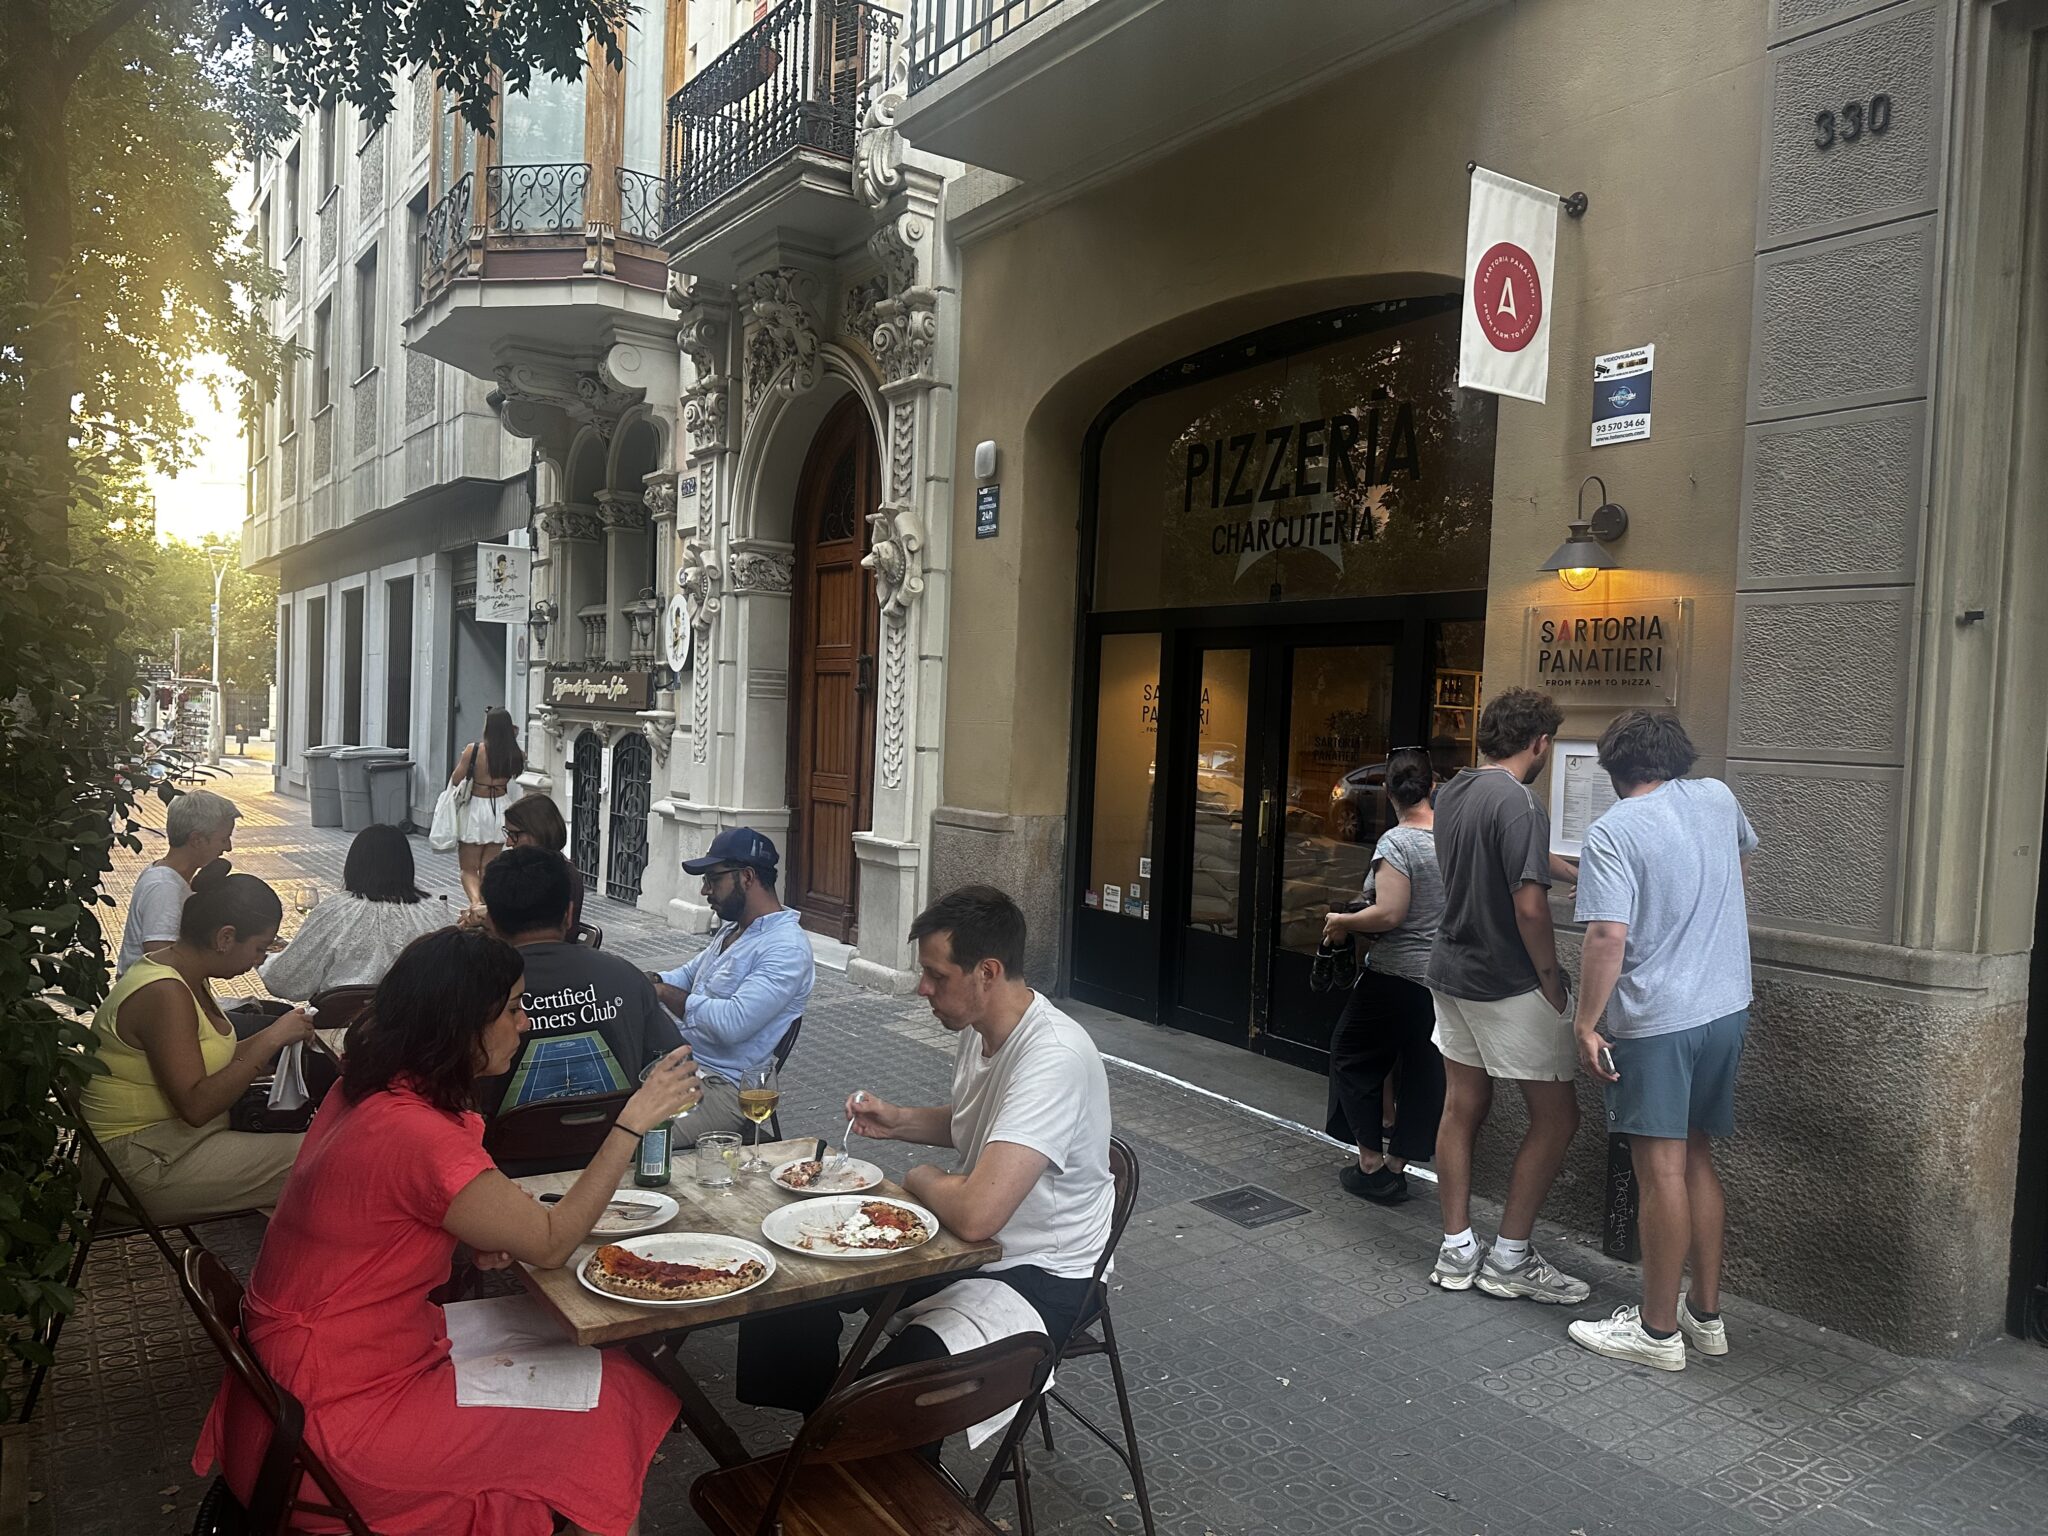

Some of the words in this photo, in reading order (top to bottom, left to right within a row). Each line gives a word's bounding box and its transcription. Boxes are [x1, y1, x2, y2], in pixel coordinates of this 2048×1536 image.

[1815, 94, 1890, 147] 330
[1484, 256, 1508, 283] SARTORIA
[1596, 425, 1606, 433] 93
[1608, 423, 1622, 432] 570
[1624, 421, 1633, 429] 34
[1635, 418, 1645, 427] 66
[1212, 506, 1375, 555] CHARCUTERIA
[1541, 615, 1663, 643] SARTORIA
[1538, 647, 1662, 673] PANATIERI
[1621, 678, 1651, 686] PIZZA
[520, 984, 597, 1011] Certified
